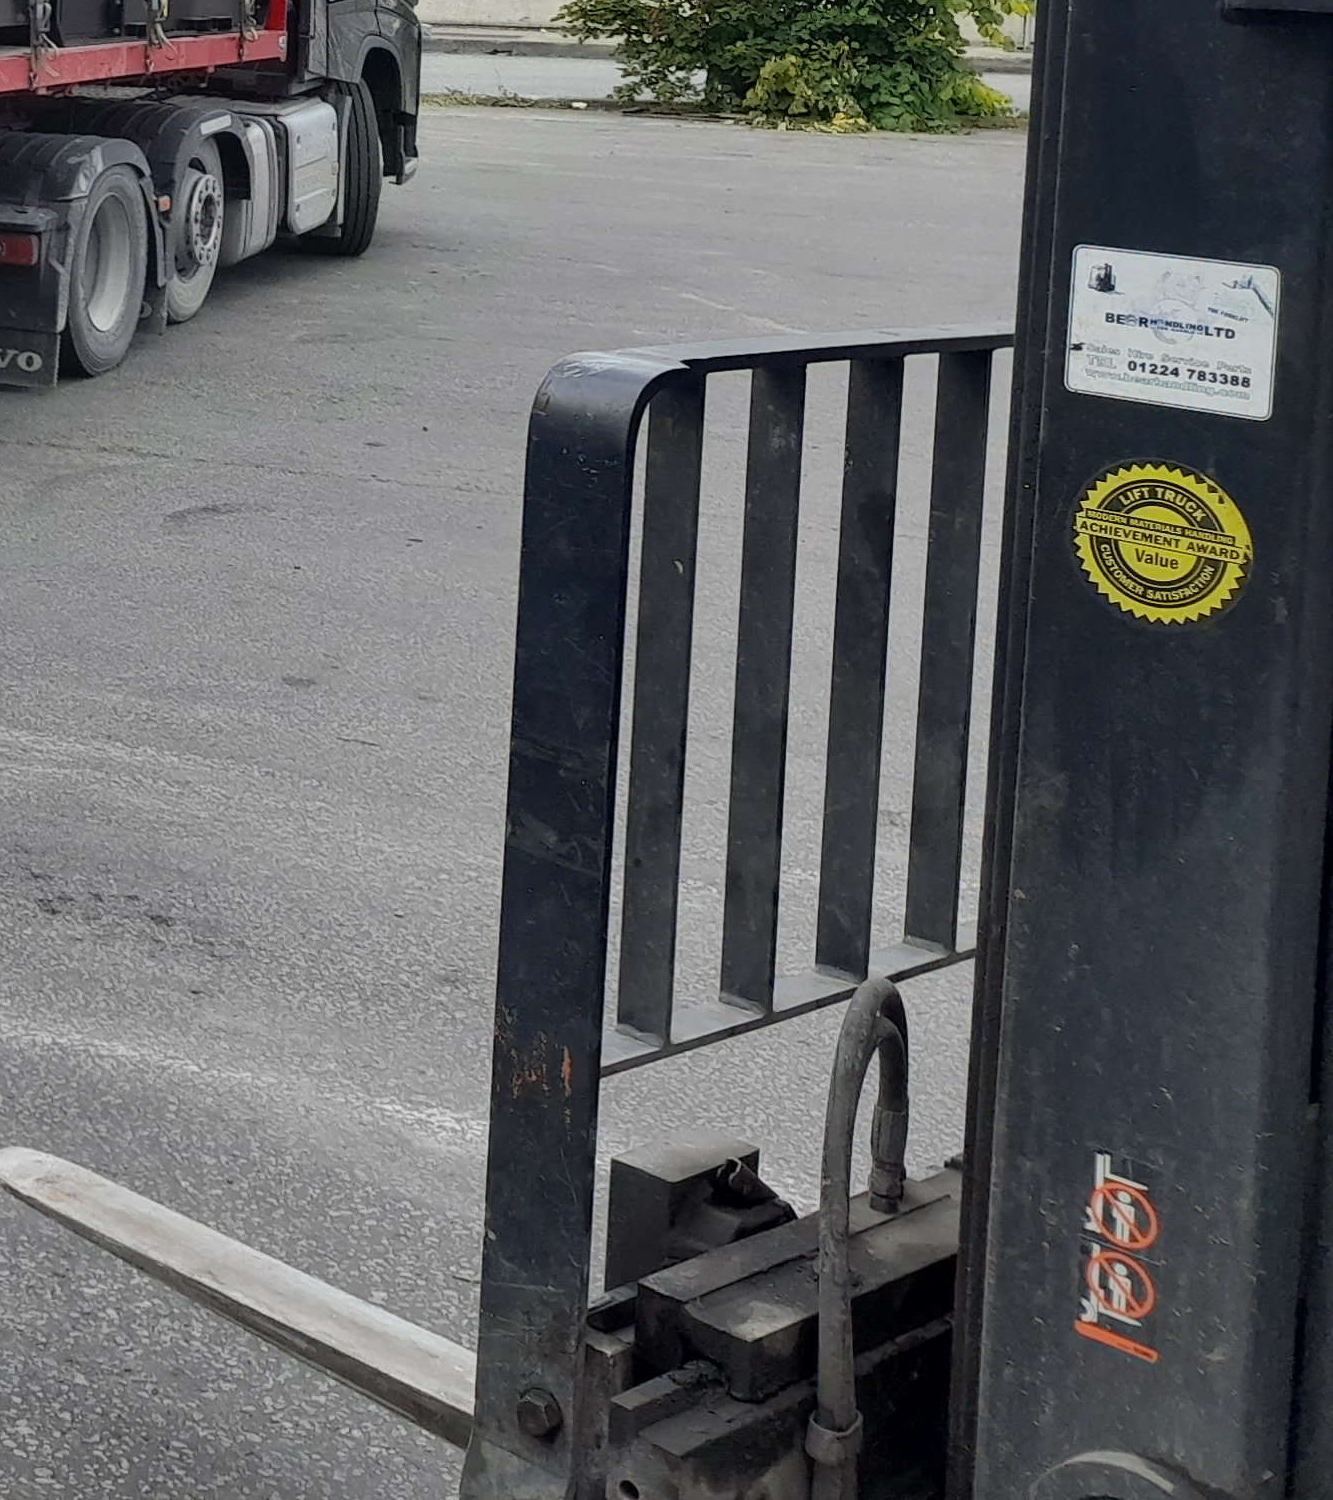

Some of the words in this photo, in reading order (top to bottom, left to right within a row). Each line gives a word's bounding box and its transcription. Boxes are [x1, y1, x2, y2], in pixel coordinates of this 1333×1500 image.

[1086, 343, 1121, 356] Sales
[1128, 348, 1154, 360] Hire
[1161, 353, 1210, 368] Service
[1217, 361, 1252, 375] Parts
[1086, 354, 1117, 369] TEL
[1127, 360, 1180, 378] 01224
[1187, 368, 1251, 388] 783388
[1118, 487, 1151, 506] LIFT
[1155, 487, 1207, 522] TRUCK
[1080, 520, 1180, 549] ACHIEVEMENT
[1186, 541, 1240, 561] AWARD
[1087, 510, 1127, 525] MODERN
[1130, 518, 1182, 535] MATERIALS
[1185, 529, 1233, 545] HANDLING
[1100, 543, 1144, 596] CUSTOMER
[1147, 565, 1215, 601] SATISFACTION
[1135, 548, 1179, 570] Value
